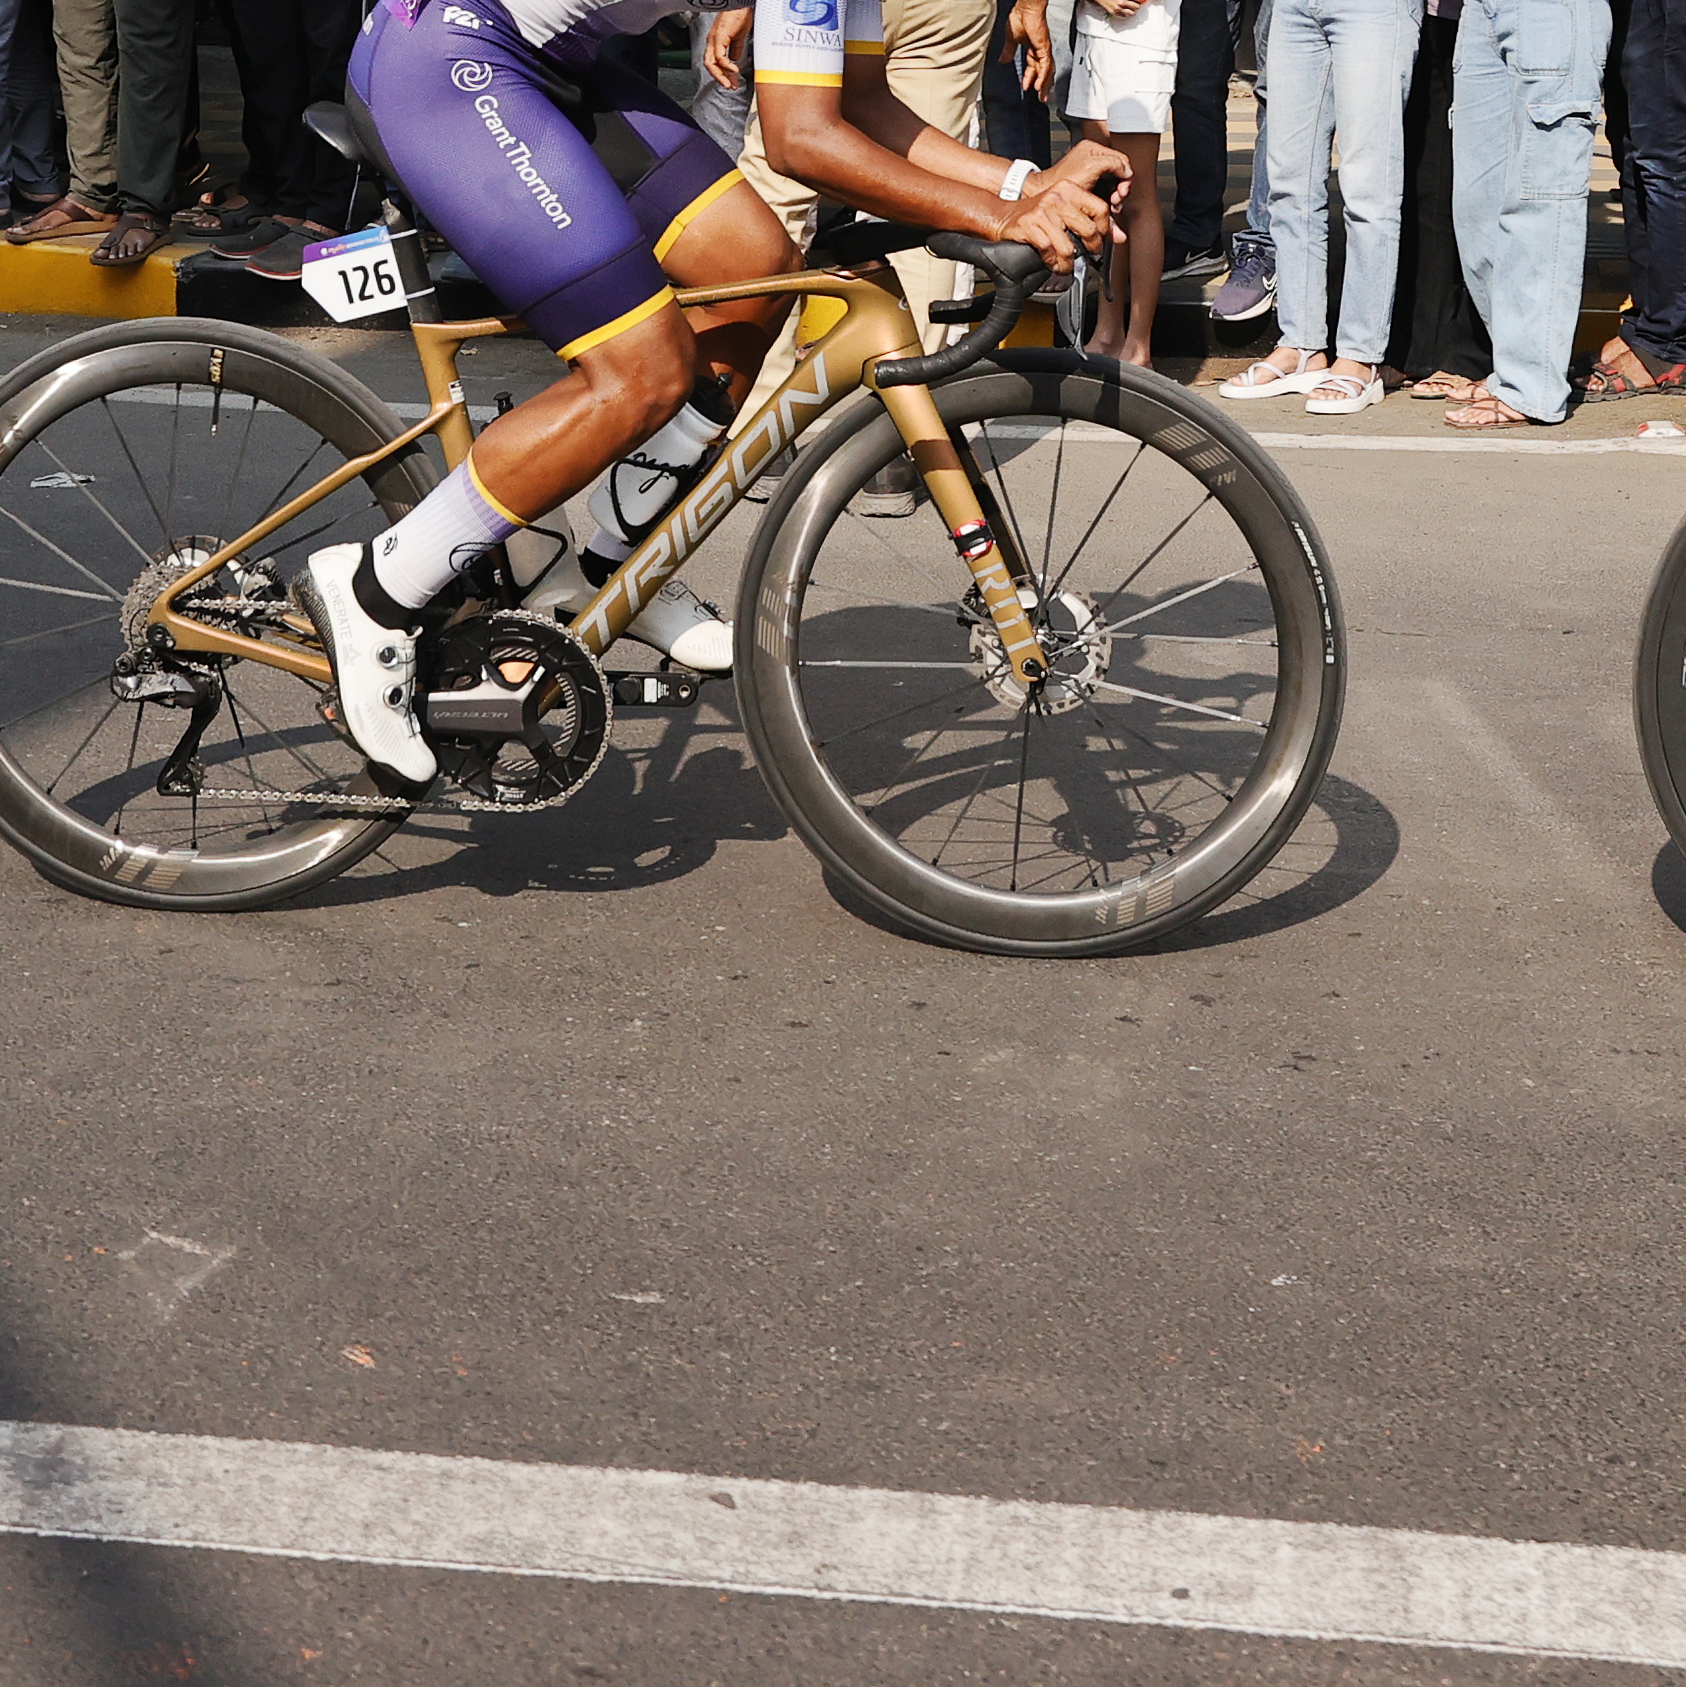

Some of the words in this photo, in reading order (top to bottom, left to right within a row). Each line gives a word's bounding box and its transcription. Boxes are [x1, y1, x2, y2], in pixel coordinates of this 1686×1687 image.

[784, 26, 842, 47] SINWA
[472, 94, 518, 151] Grant
[504, 139, 572, 231] Thornton
[338, 259, 397, 304] 126
[576, 354, 834, 648] TRIGON
[324, 578, 353, 650] VENERATE
